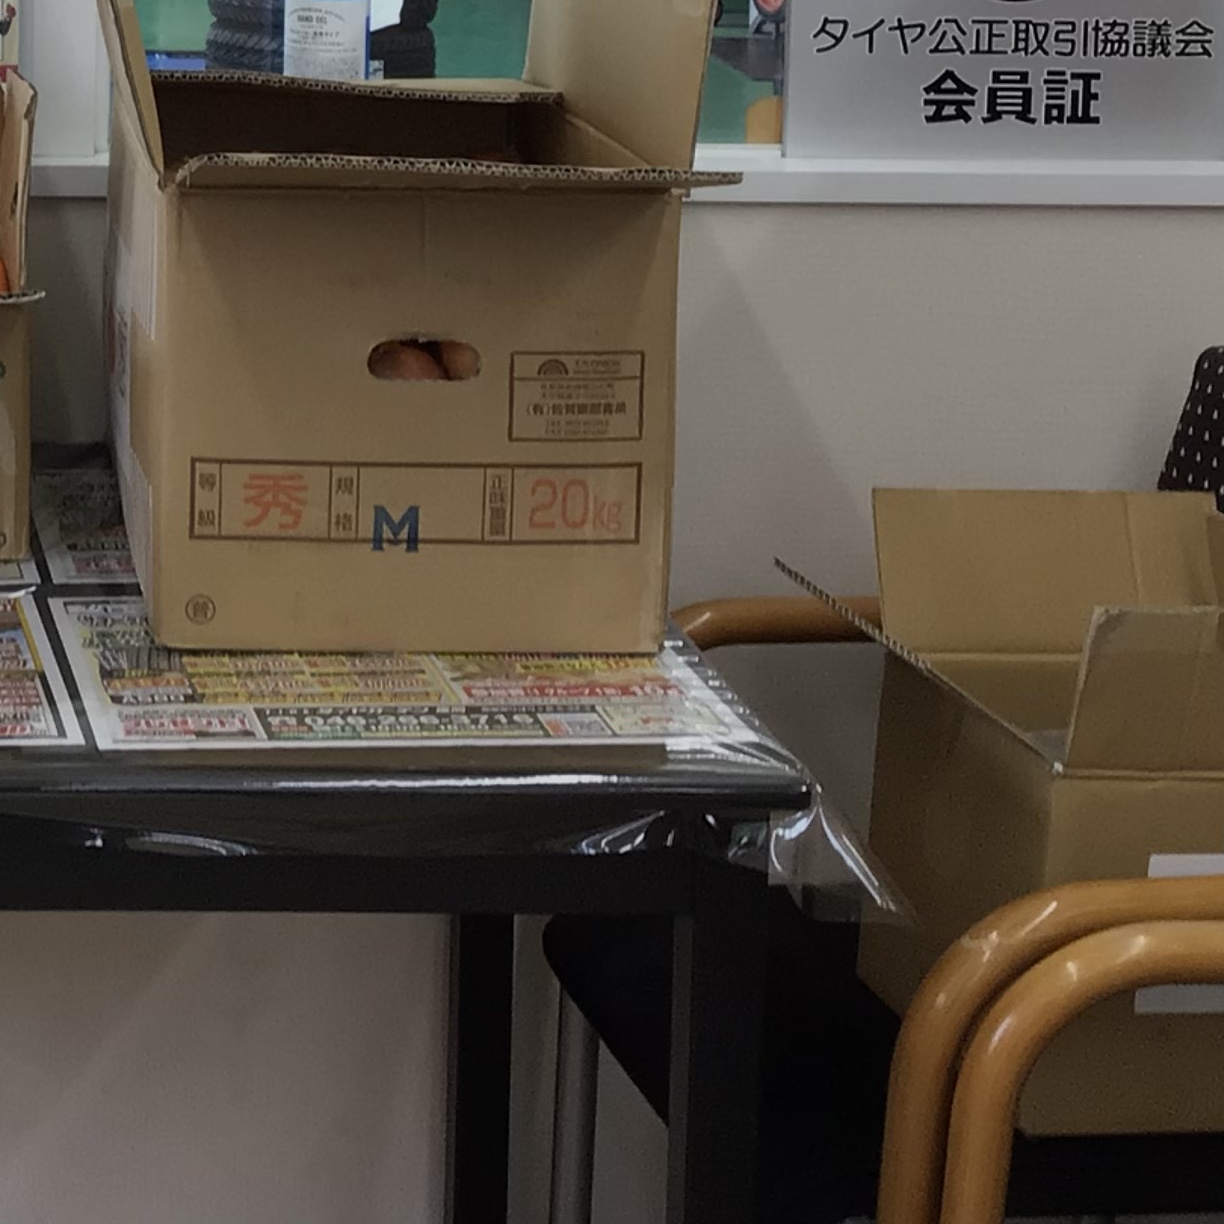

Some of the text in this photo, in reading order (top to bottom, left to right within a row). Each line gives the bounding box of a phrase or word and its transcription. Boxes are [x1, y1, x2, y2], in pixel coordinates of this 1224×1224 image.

[812, 16, 1214, 58] タイヤ公正取引協議会
[922, 69, 1102, 125] 会員証
[242, 473, 309, 530] 秀
[371, 504, 420, 553] M
[528, 478, 623, 533] 20kg
